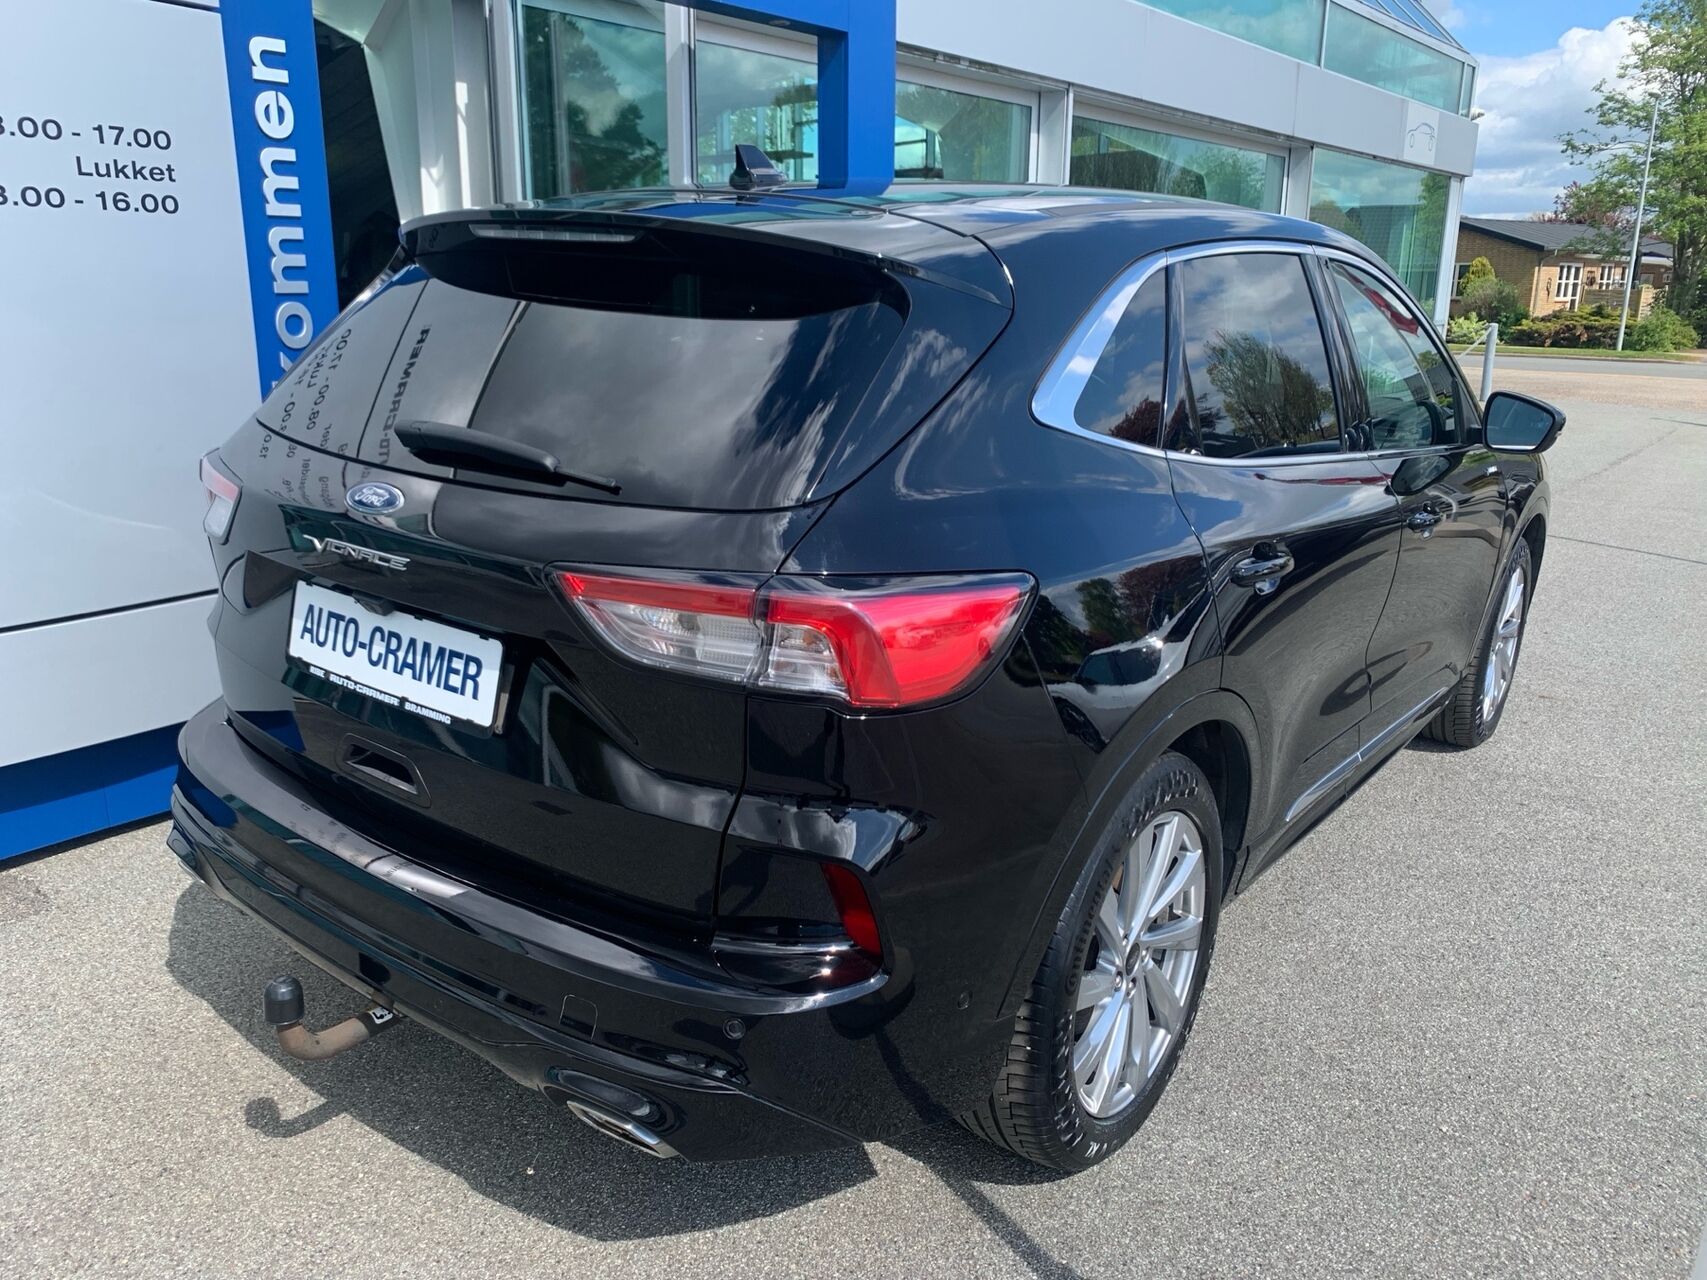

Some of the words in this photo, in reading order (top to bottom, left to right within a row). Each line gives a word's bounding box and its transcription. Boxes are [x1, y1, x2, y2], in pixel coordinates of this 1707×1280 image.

[0, 116, 62, 141] .00
[92, 124, 172, 150] 17.00
[75, 155, 176, 183] Lukket
[95, 190, 179, 214] 16.00
[249, 35, 313, 389] ommen
[354, 485, 390, 507] Ford
[302, 533, 411, 571] VIGNALE
[300, 603, 483, 700] AUTO-CRAMER
[329, 674, 400, 707] AUTO-CRAMER
[404, 701, 452, 725] BRAMMING
